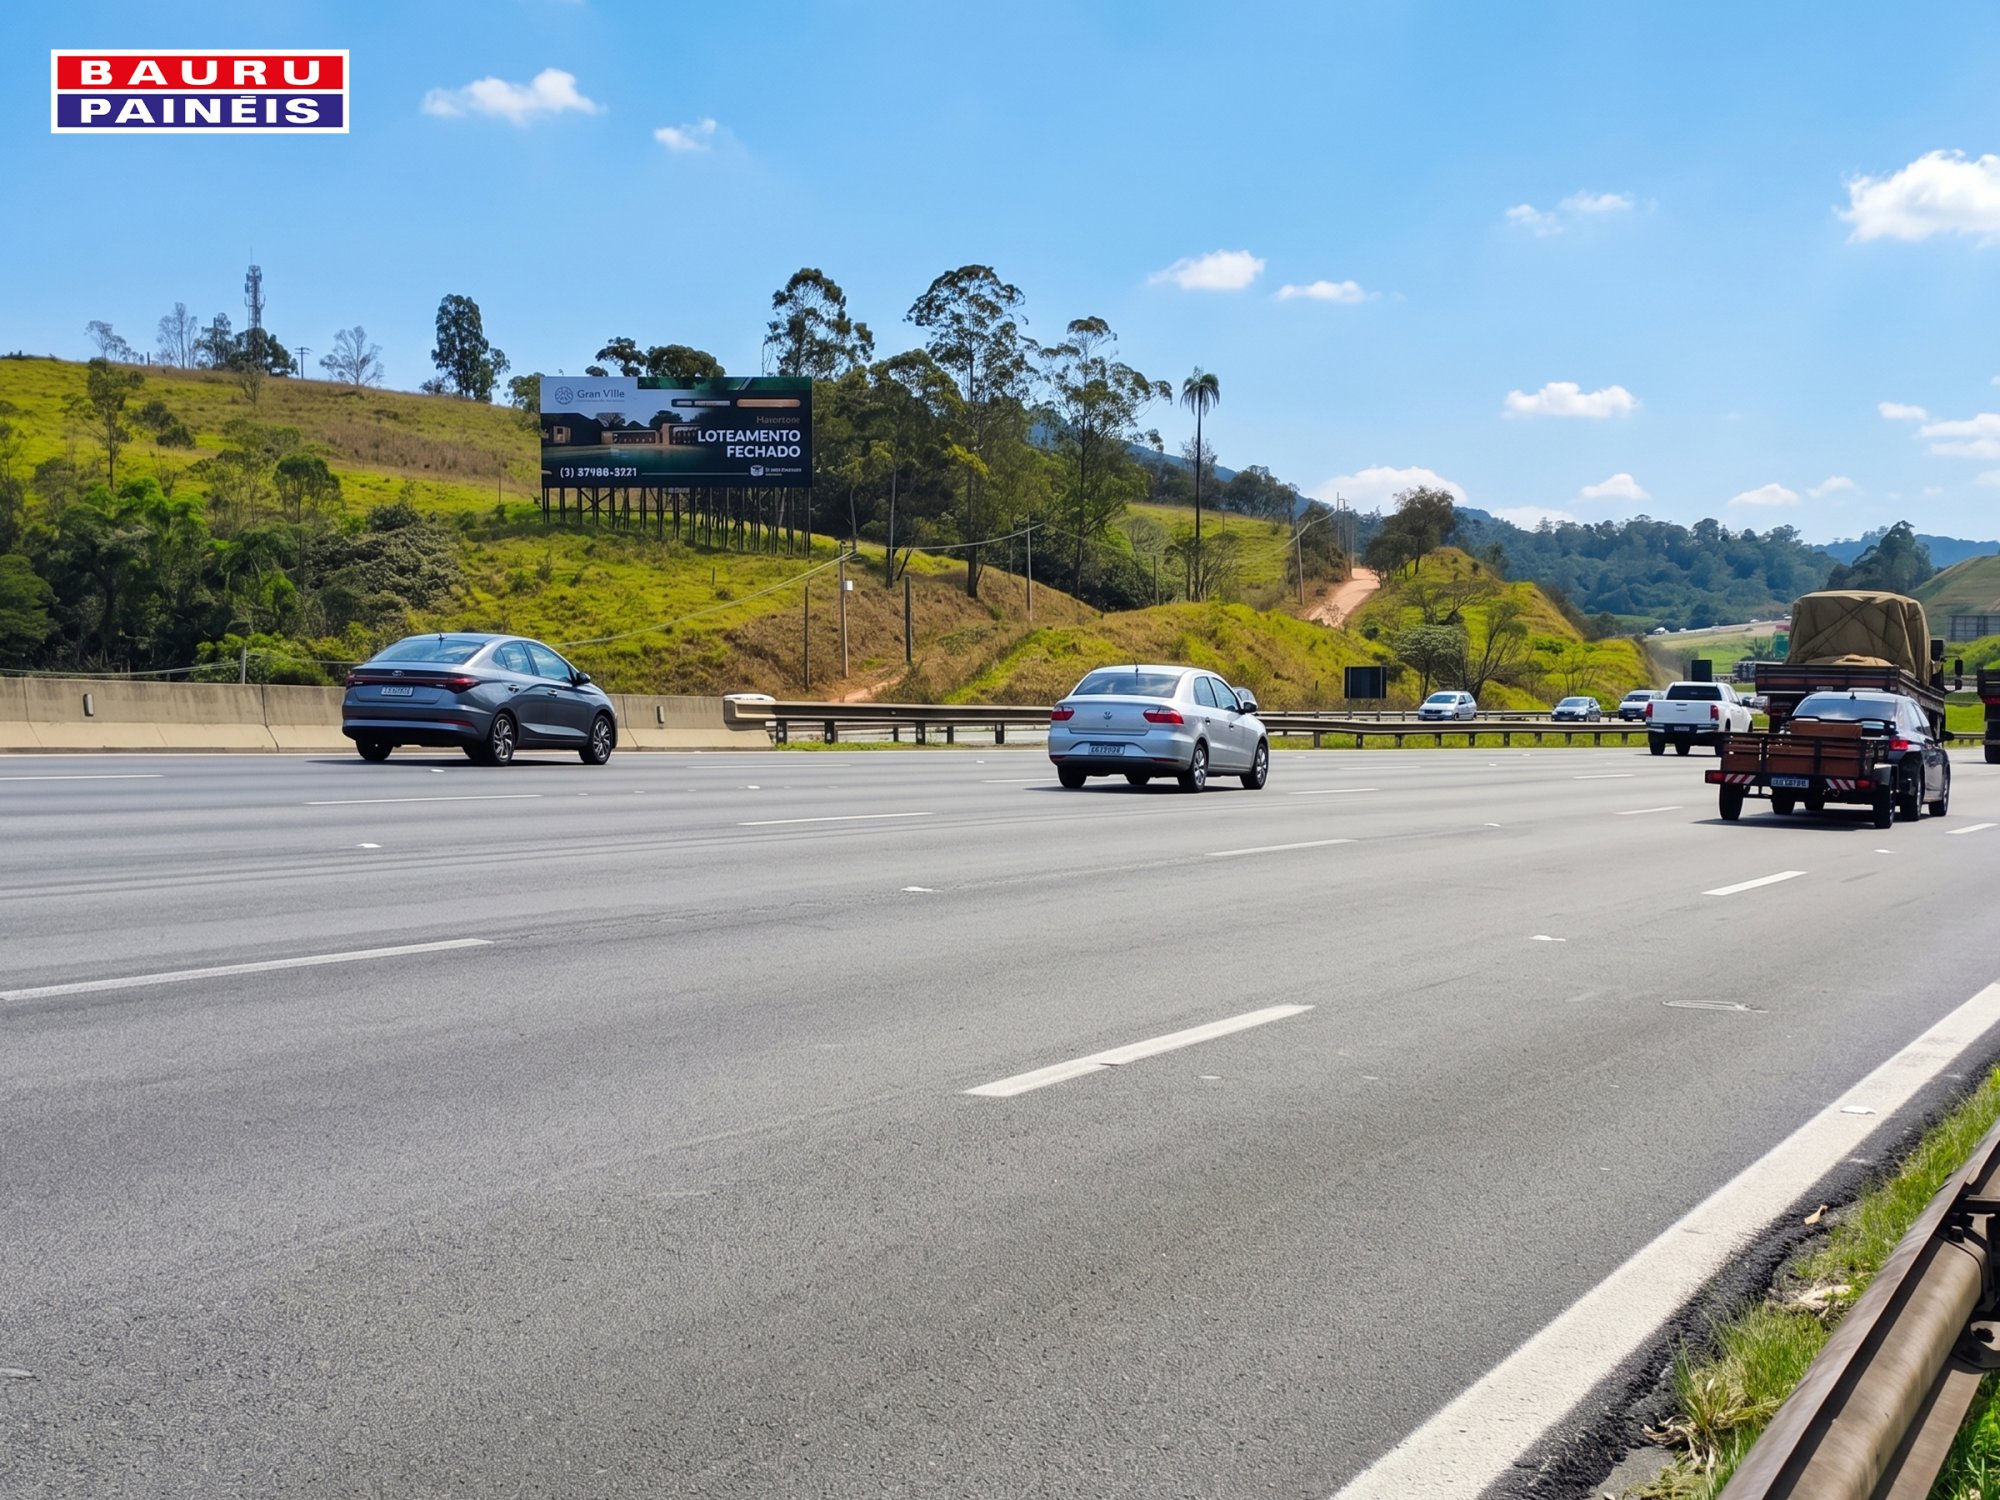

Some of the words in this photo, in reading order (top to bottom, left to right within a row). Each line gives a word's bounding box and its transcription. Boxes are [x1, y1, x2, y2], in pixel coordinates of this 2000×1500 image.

[577, 389, 601, 399] Gran
[603, 389, 625, 399] Ville
[697, 430, 801, 442] LOTEAMENTO
[727, 445, 801, 458] FECHADO
